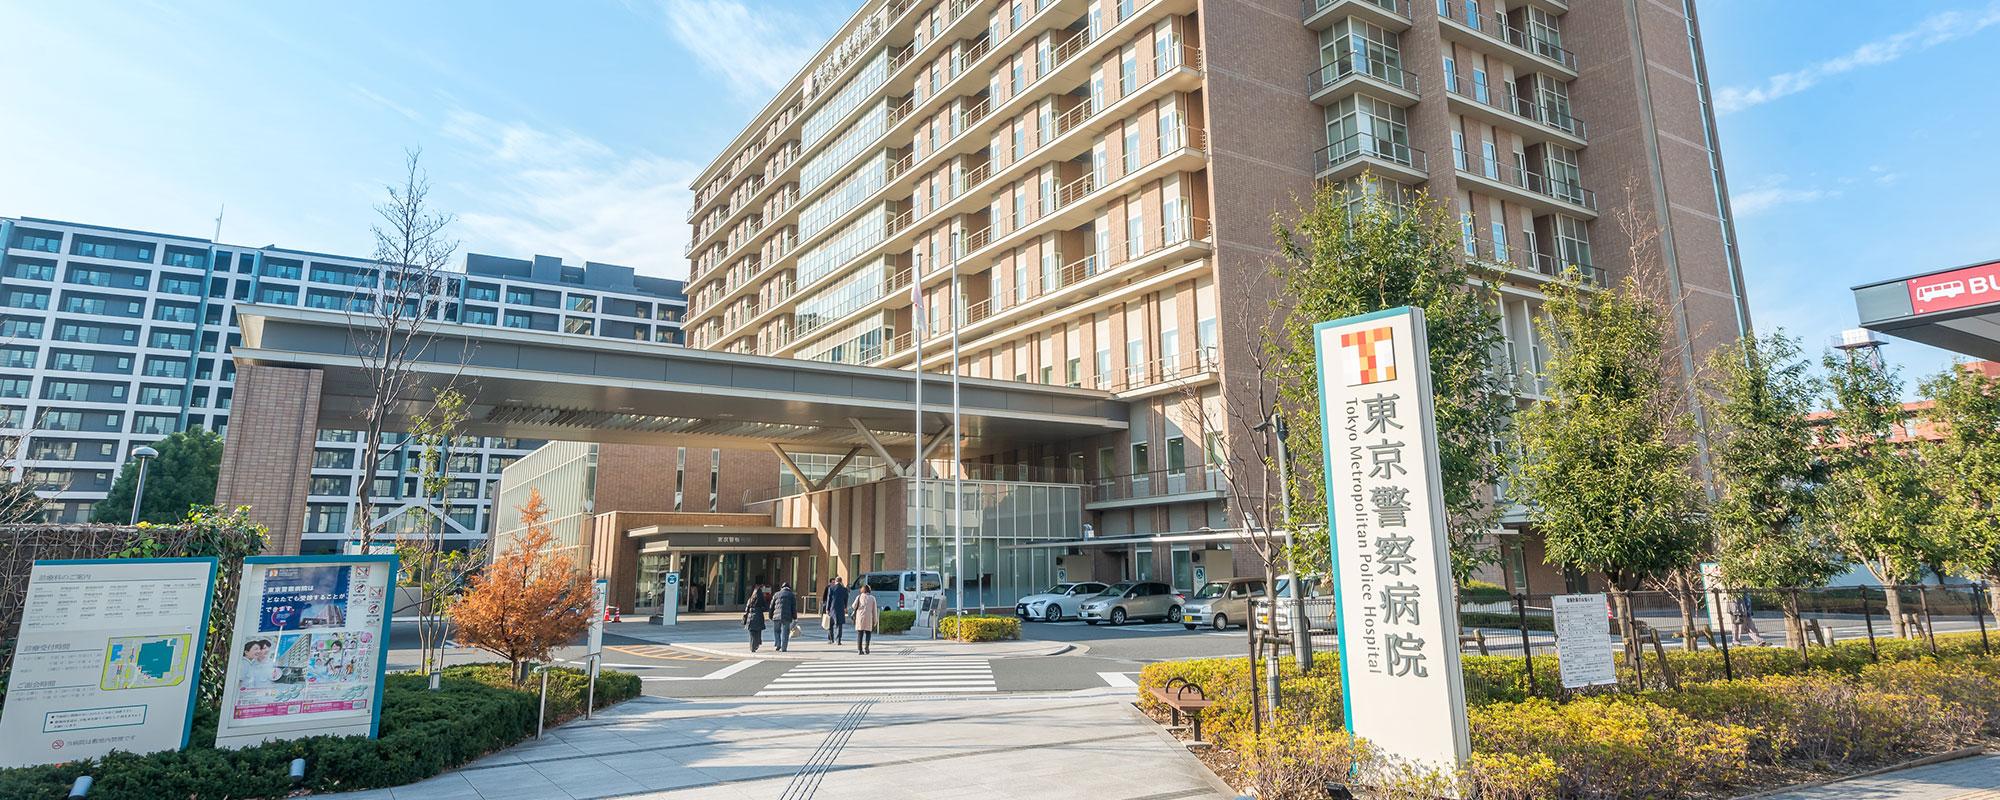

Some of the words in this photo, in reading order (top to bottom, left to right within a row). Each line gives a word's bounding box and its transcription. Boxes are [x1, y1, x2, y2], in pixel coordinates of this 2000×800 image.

[1345, 397, 1359, 441] Tokyo
[1350, 446, 1369, 548] Metropolitan
[1361, 393, 1428, 678] 東京警察病院
[1359, 554, 1374, 600] Police
[1363, 606, 1382, 674] Hospital
